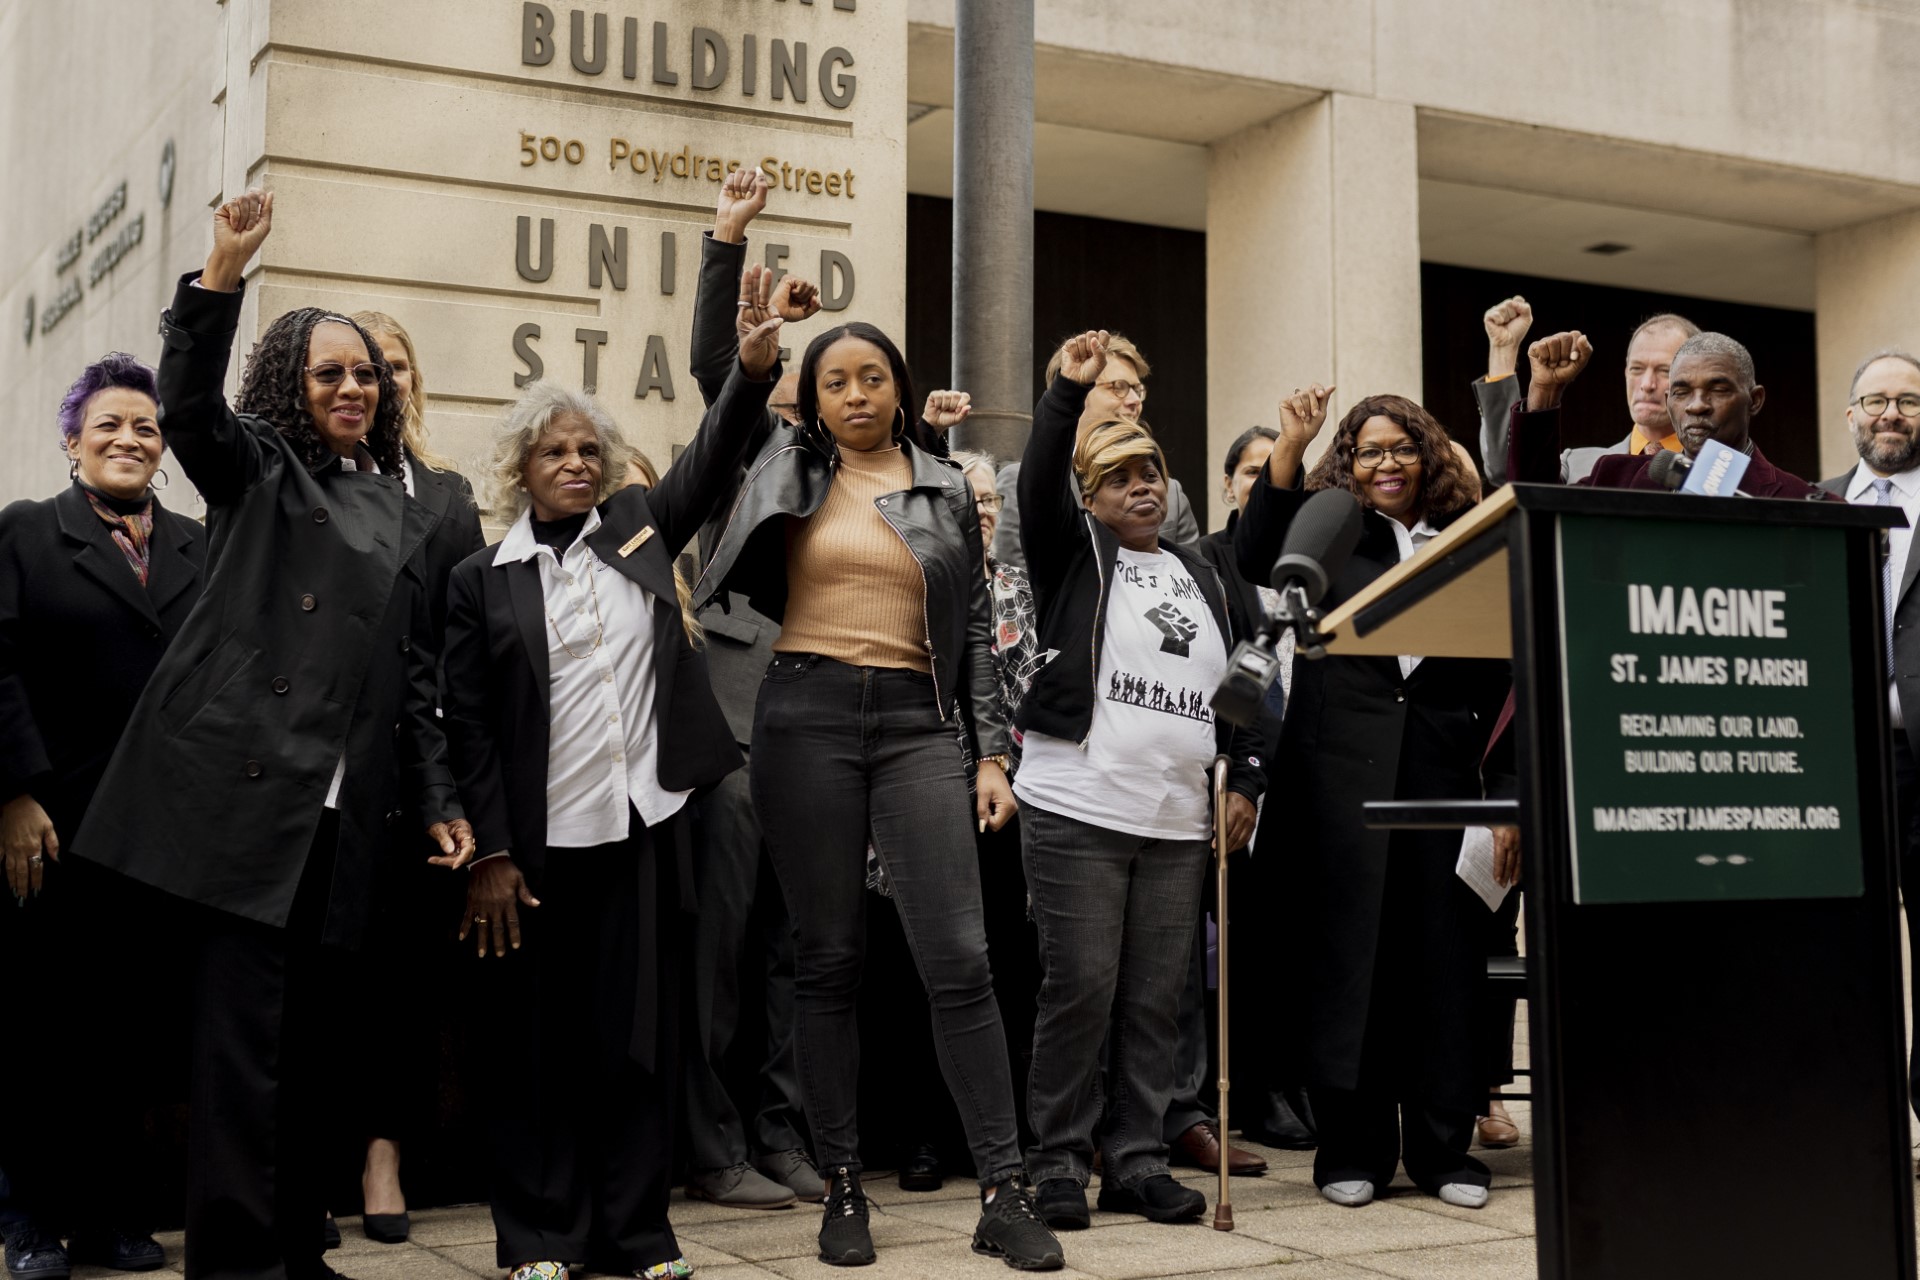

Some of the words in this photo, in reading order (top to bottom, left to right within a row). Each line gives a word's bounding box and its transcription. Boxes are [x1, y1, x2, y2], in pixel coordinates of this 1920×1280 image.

[522, 1, 857, 108] BUILDING
[520, 132, 586, 167] 500
[610, 137, 741, 183] Poydras
[760, 156, 855, 198] Street
[515, 215, 855, 311] UNIED
[1627, 583, 1788, 639] IMAGINE
[1610, 654, 1648, 683] ST.
[1656, 655, 1729, 685] JAMES
[1734, 657, 1809, 687] PARISH
[1619, 714, 1717, 738] RECLAIMING
[1719, 715, 1753, 738] OUR
[1756, 716, 1804, 739] LAND.
[1624, 749, 1697, 773] BUILDING
[1699, 751, 1734, 773] OUR
[1737, 751, 1804, 774] FUTURE.
[1592, 805, 1841, 832] IMAGINESTJAMESPARISH.ORG
